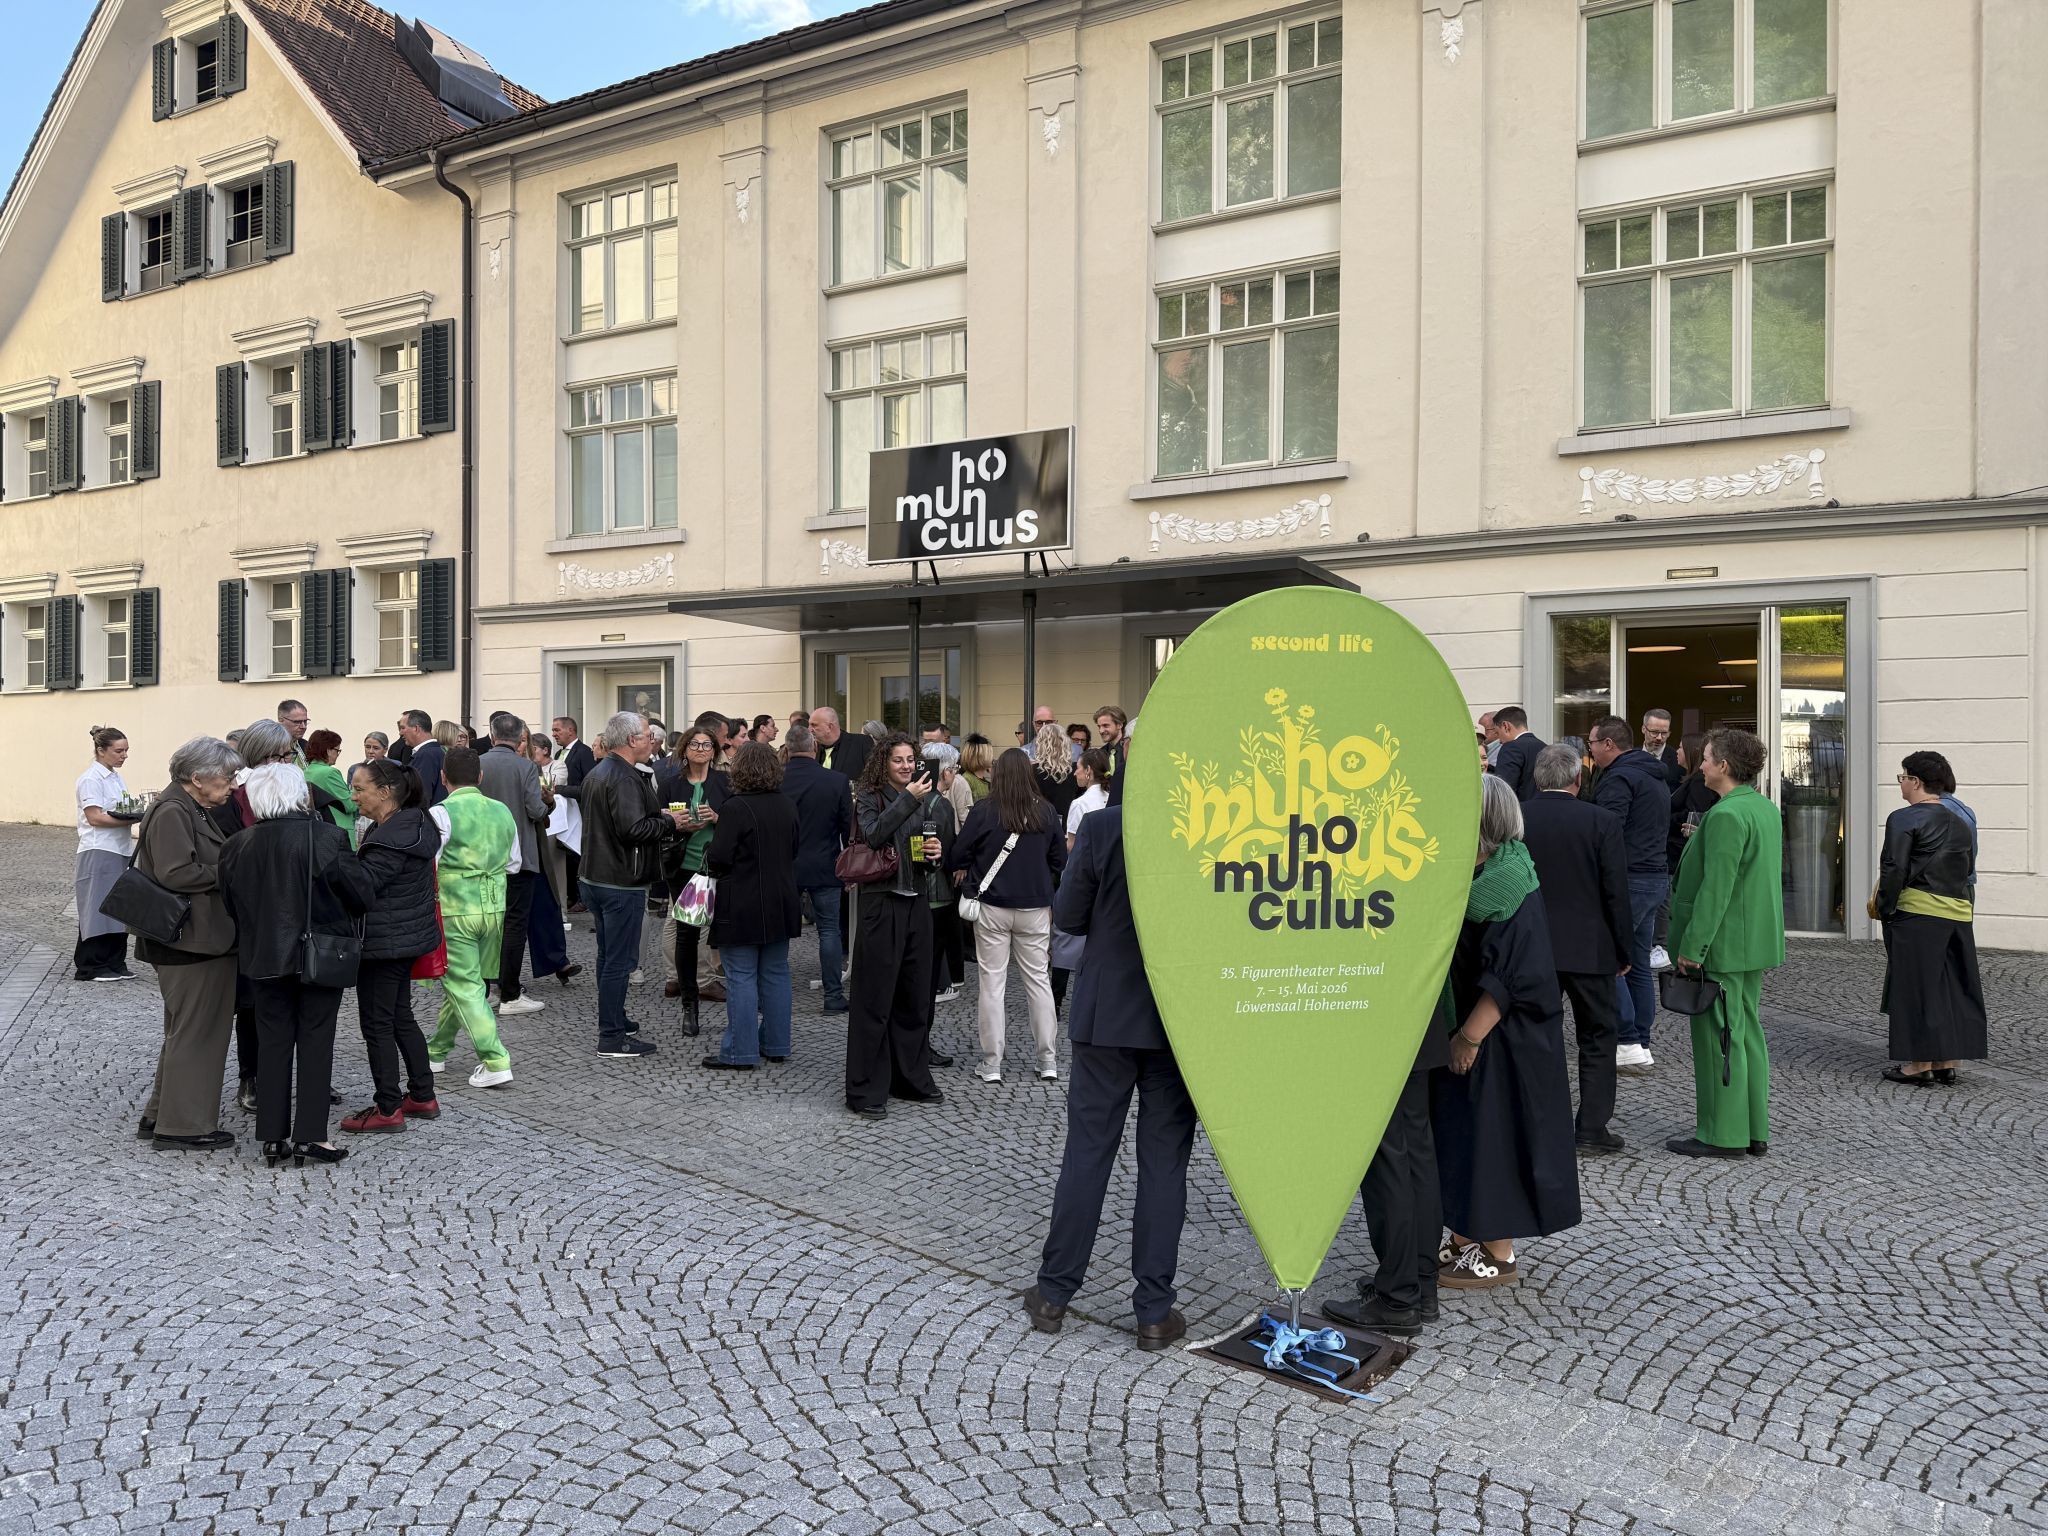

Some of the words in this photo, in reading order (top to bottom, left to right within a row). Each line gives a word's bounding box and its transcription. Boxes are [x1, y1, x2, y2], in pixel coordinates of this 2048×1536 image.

[952, 447, 1007, 484] ho
[896, 485, 987, 522] mun
[921, 509, 1039, 550] culus
[1250, 633, 1329, 652] second
[1338, 633, 1373, 652] life
[1289, 814, 1358, 854] ho
[1214, 853, 1332, 892] mun
[1248, 890, 1395, 931] culus
[1220, 967, 1238, 979] 35.
[1242, 964, 1335, 981] Figurentheater
[1338, 962, 1385, 976] Festival
[1256, 986, 1265, 998] 7.
[1278, 986, 1293, 998] 15.
[1296, 982, 1318, 995] Mai
[1321, 982, 1348, 994] 2026
[1235, 998, 1301, 1014] Löwensaal
[1304, 998, 1369, 1011] Hohenems
